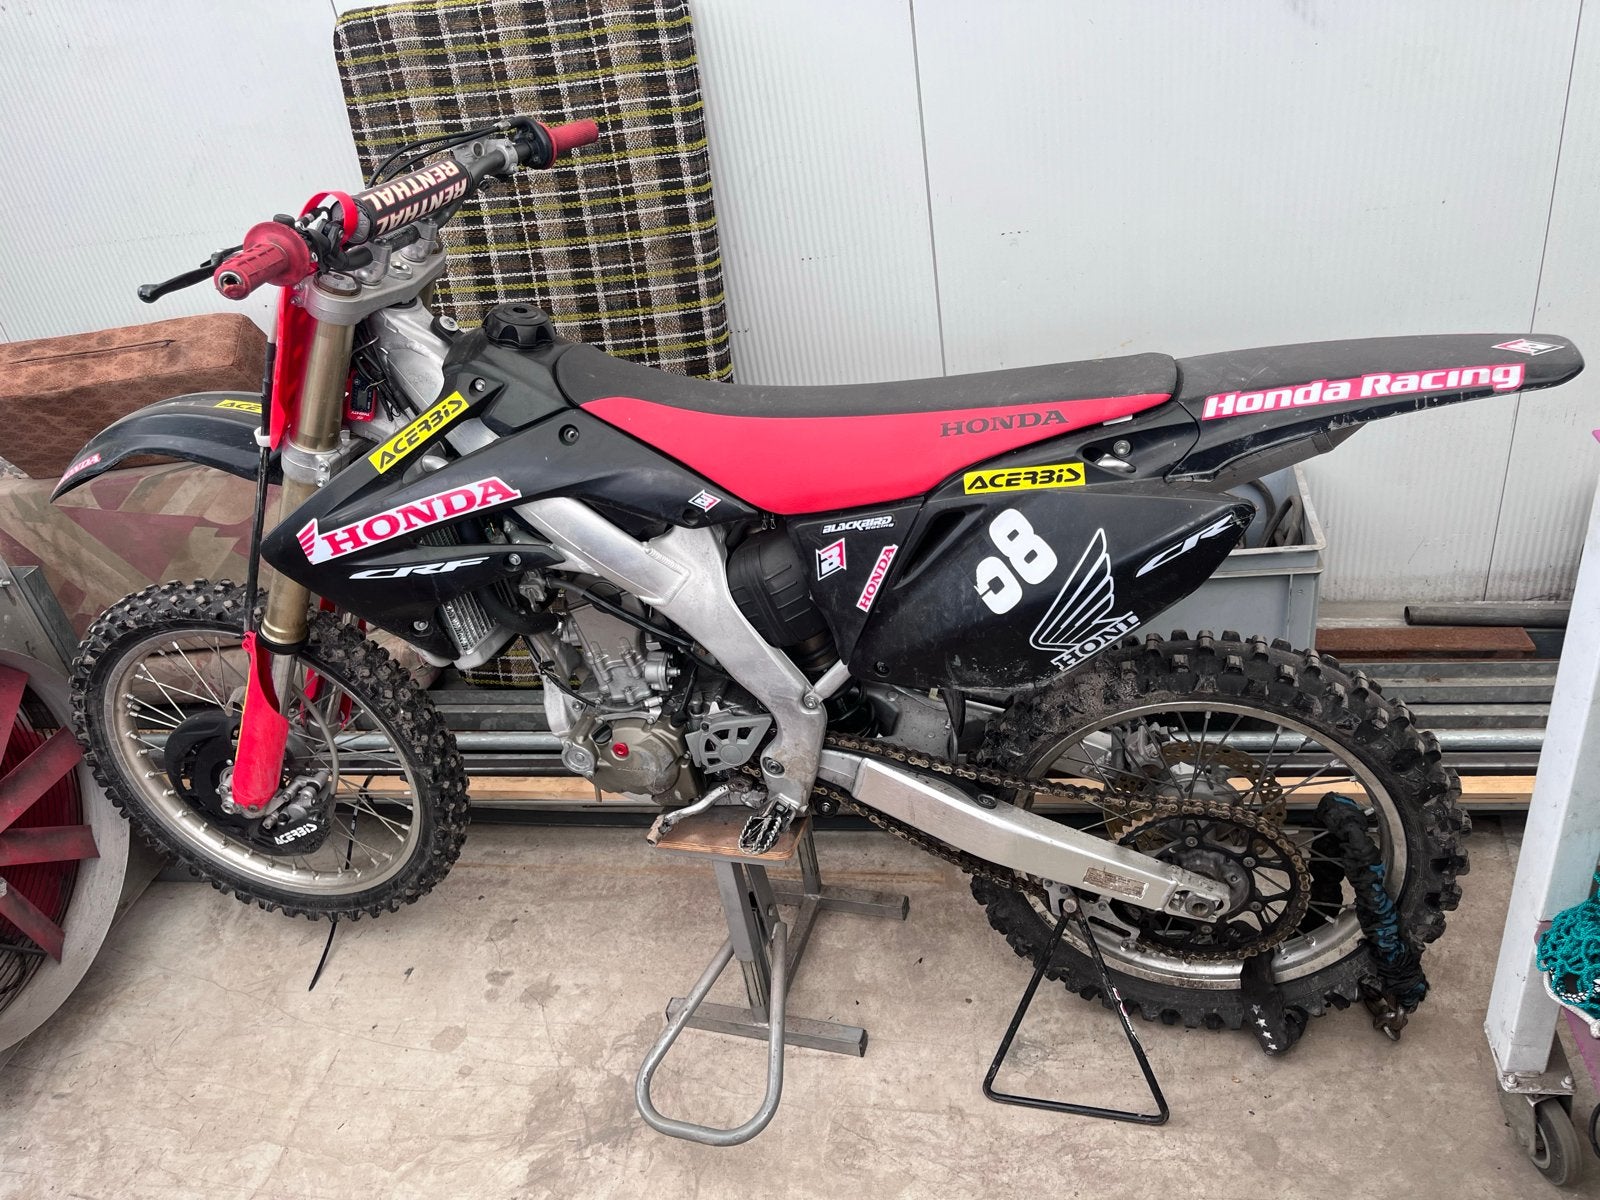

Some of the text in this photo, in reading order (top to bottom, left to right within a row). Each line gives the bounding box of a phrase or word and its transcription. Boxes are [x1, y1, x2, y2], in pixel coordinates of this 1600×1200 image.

[361, 160, 459, 210] RENTHAL
[376, 178, 467, 236] RENTHAL
[1204, 365, 1517, 418] Honda Racing
[940, 410, 1069, 437] HONDA
[321, 479, 519, 556] HONDA
[823, 516, 892, 533] BLACKBIRD
[349, 556, 490, 579] CRF
[858, 546, 896, 611] HONDA
